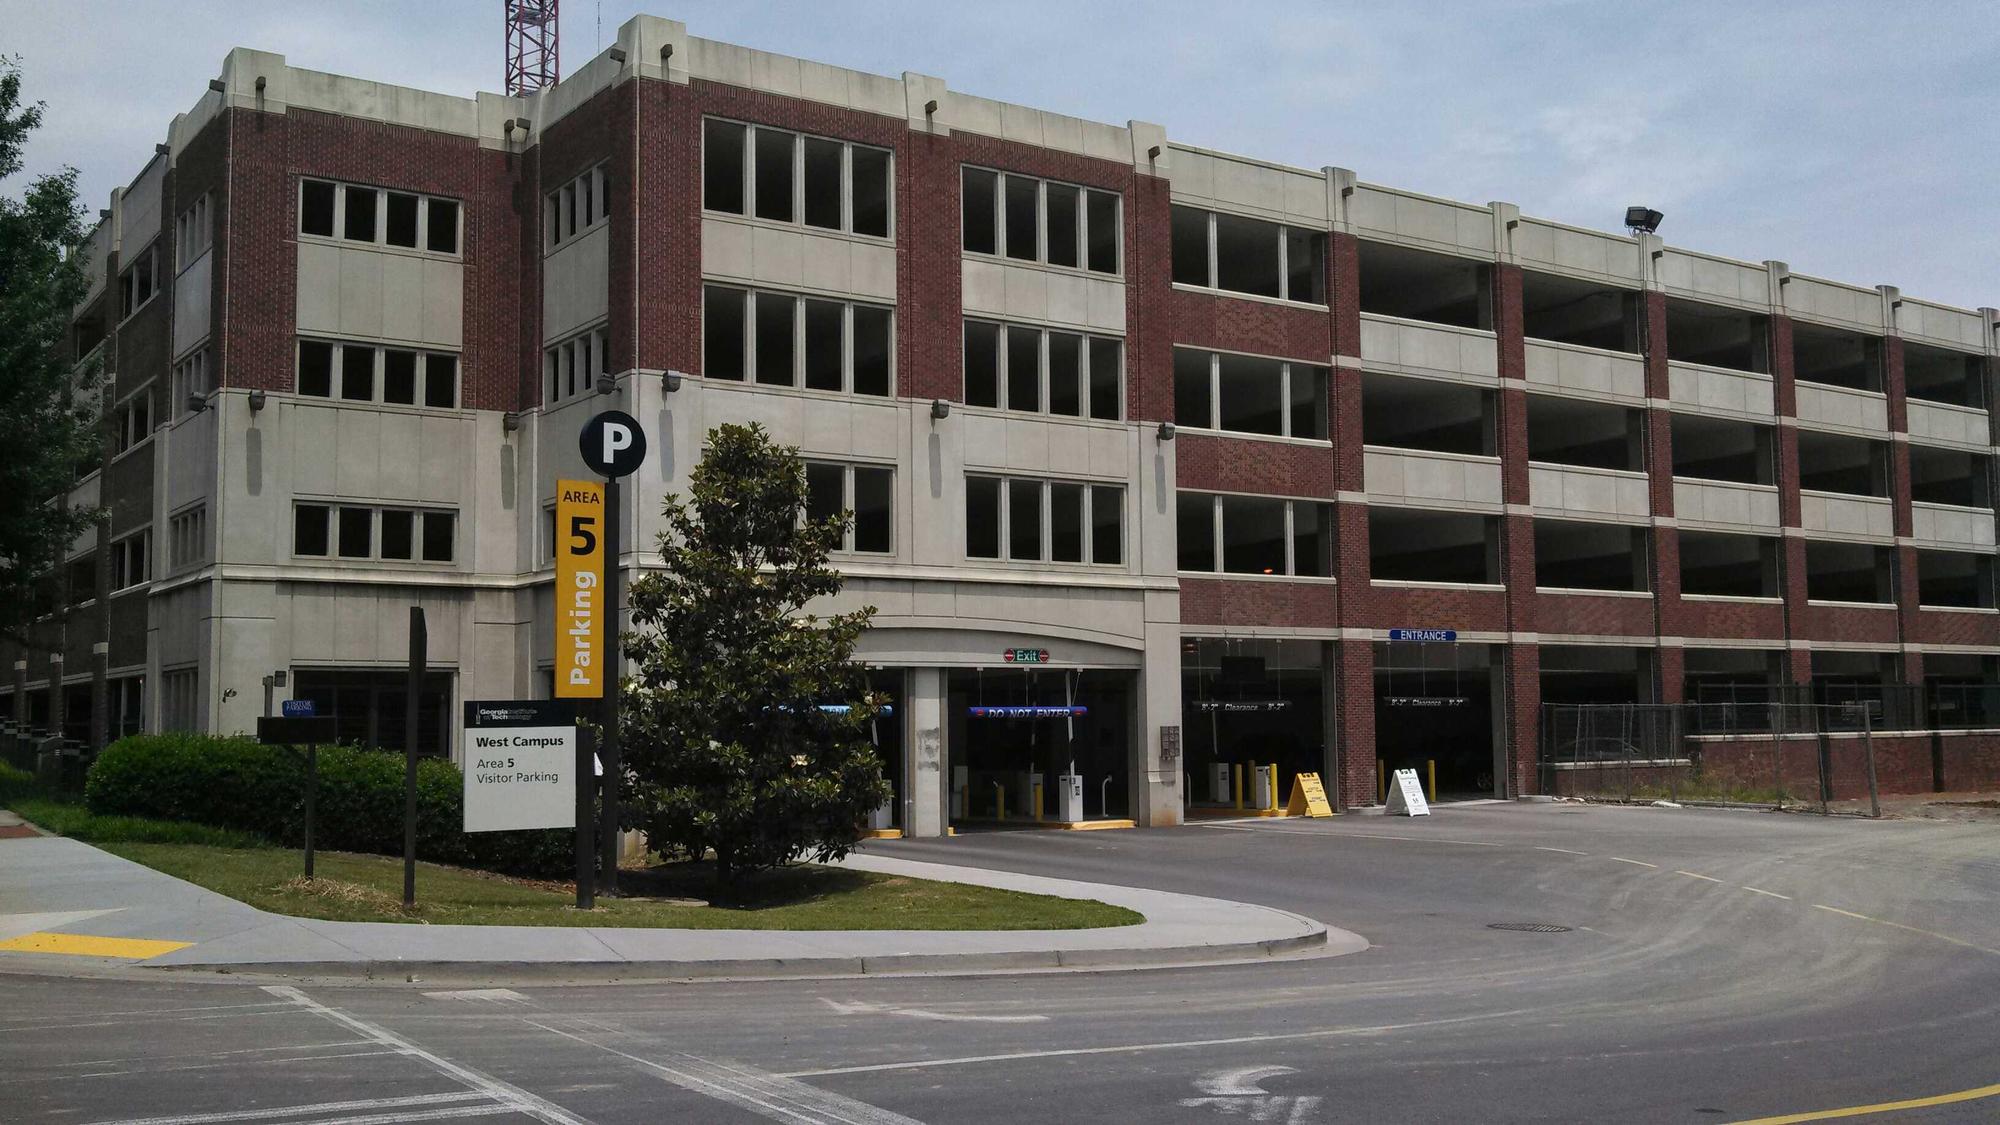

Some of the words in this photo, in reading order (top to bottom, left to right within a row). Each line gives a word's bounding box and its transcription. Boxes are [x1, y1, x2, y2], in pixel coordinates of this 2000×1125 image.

[603, 422, 632, 463] P
[563, 491, 600, 504] AREA
[571, 517, 596, 556] 5
[569, 571, 597, 685] Parking
[1400, 630, 1446, 640] ENTRANCE
[1016, 650, 1037, 661] Exit
[480, 708, 508, 716] Georgia
[1224, 703, 1258, 711] Clearance
[988, 709, 1004, 718] DO
[1009, 709, 1032, 718] NOT
[1036, 709, 1070, 718] ENTER
[476, 737, 509, 747] West
[513, 736, 564, 748] Campus
[477, 759, 504, 768] Area
[507, 758, 515, 768] 5
[476, 772, 513, 784] Visitor
[516, 772, 559, 784] Parking
